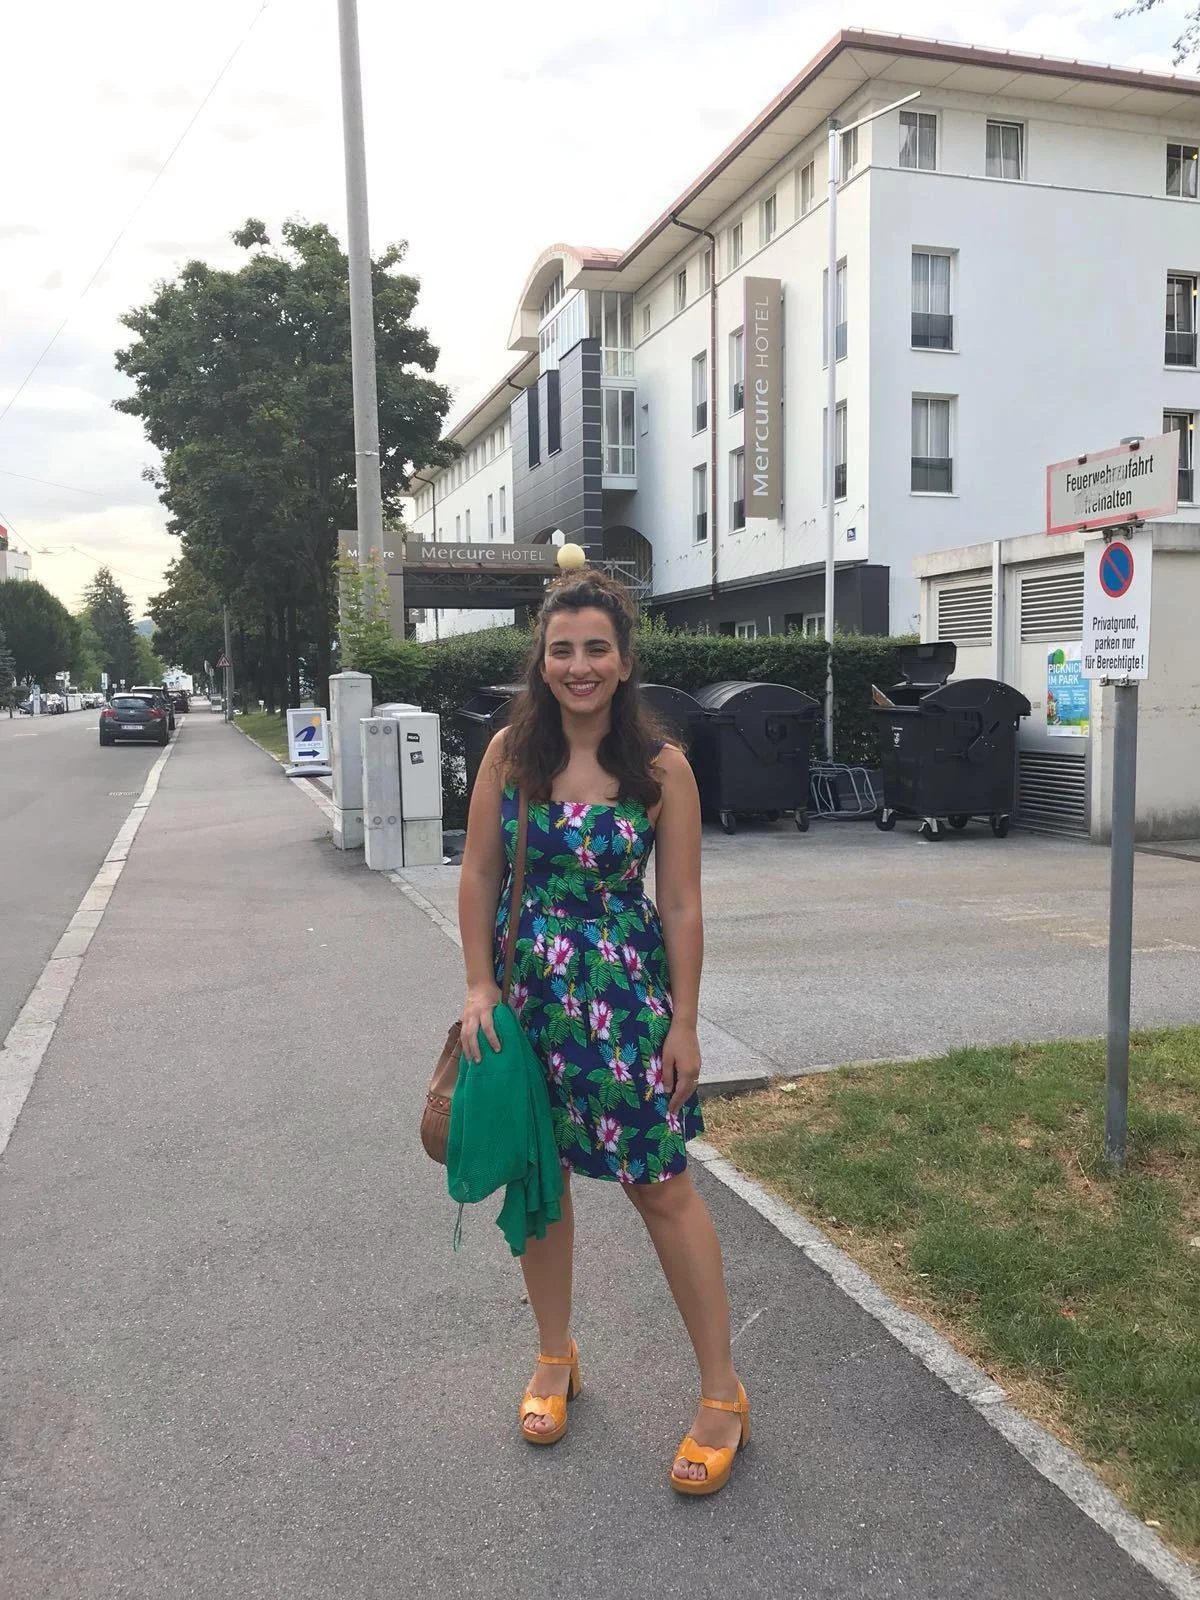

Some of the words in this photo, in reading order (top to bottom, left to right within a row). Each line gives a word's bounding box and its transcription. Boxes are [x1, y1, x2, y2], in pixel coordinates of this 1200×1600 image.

[755, 296, 769, 368] HOTEL
[753, 378, 769, 497] Mercure
[421, 546, 496, 560] Mercure
[501, 550, 546, 561] HOTEL
[1092, 614, 1139, 633] Privatgrund,
[1094, 637, 1120, 653] parken
[1122, 637, 1136, 650] nur
[1085, 655, 1095, 670] für
[1048, 675, 1057, 685] IM
[1058, 674, 1080, 685] PARK
